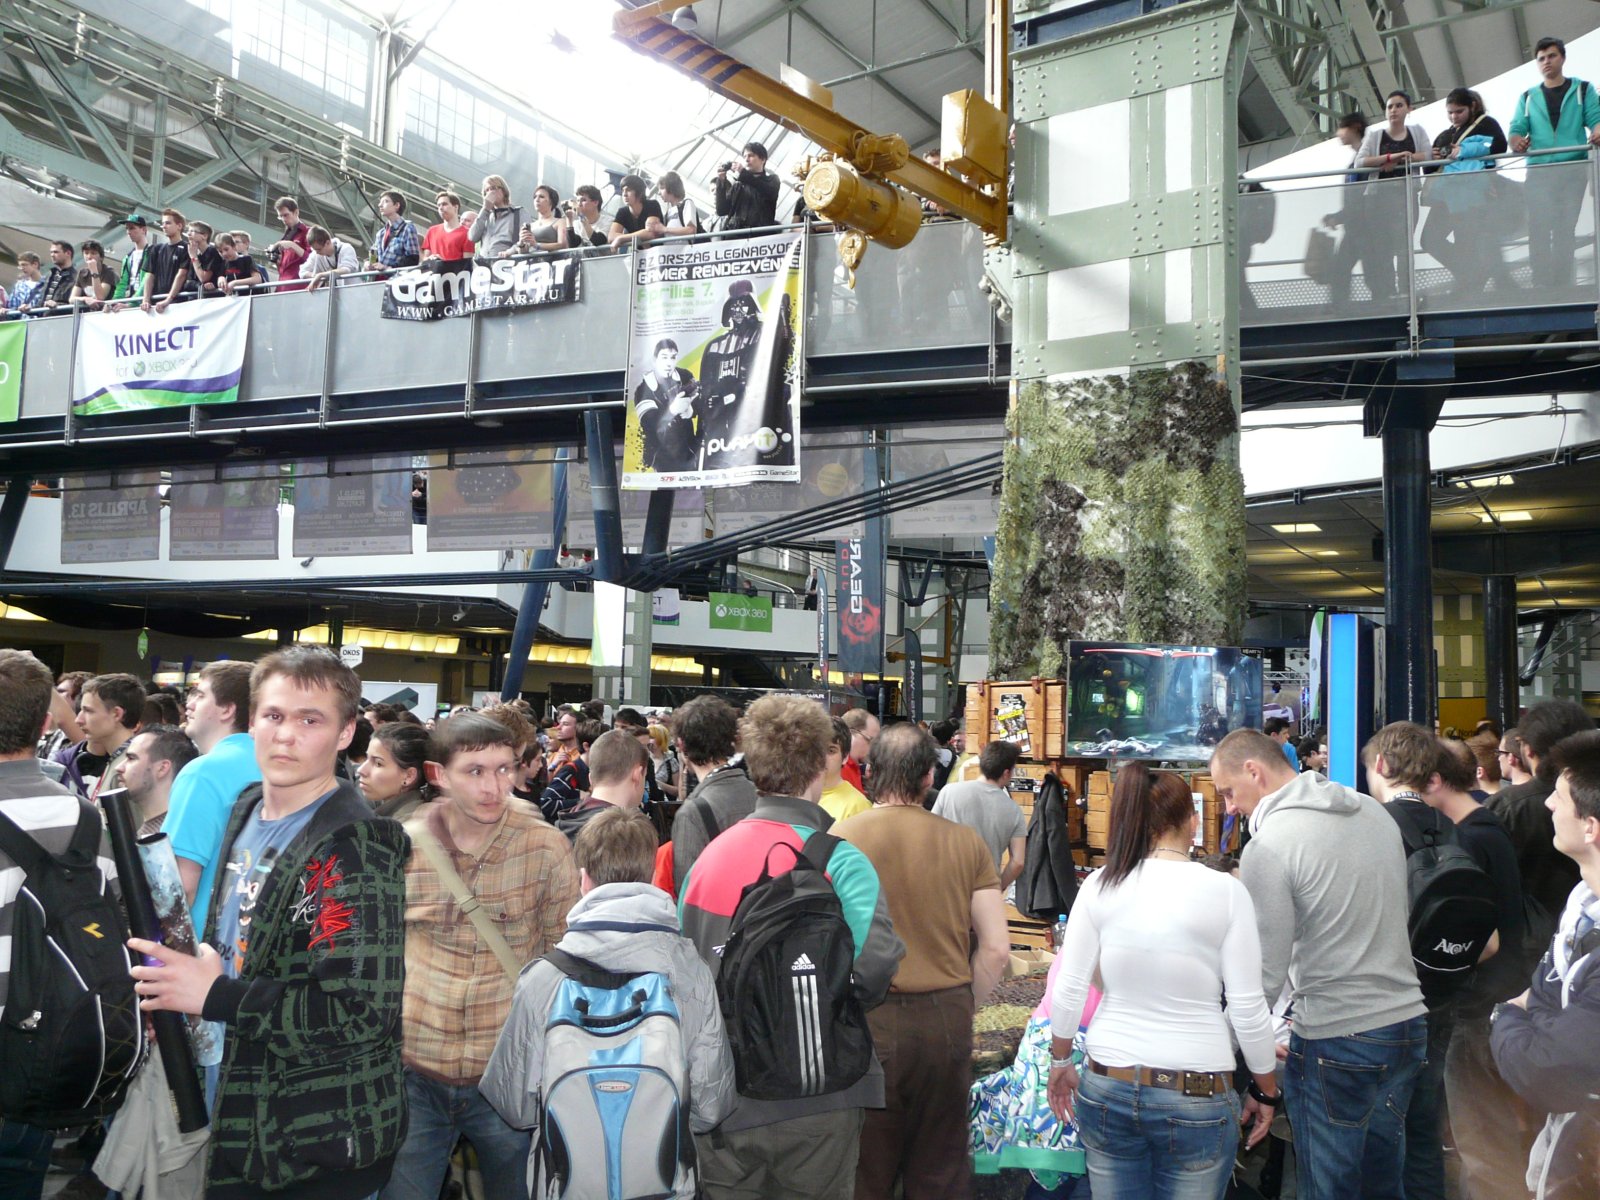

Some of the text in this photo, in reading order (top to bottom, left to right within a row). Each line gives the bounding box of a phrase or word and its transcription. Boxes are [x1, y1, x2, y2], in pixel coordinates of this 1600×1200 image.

[391, 258, 572, 304] GameStar
[638, 266, 687, 284] GAMER
[115, 325, 200, 358] KINECT
[149, 360, 177, 373] XBOX
[728, 607, 768, 618] XBOX 360
[791, 963, 816, 971] adidas
